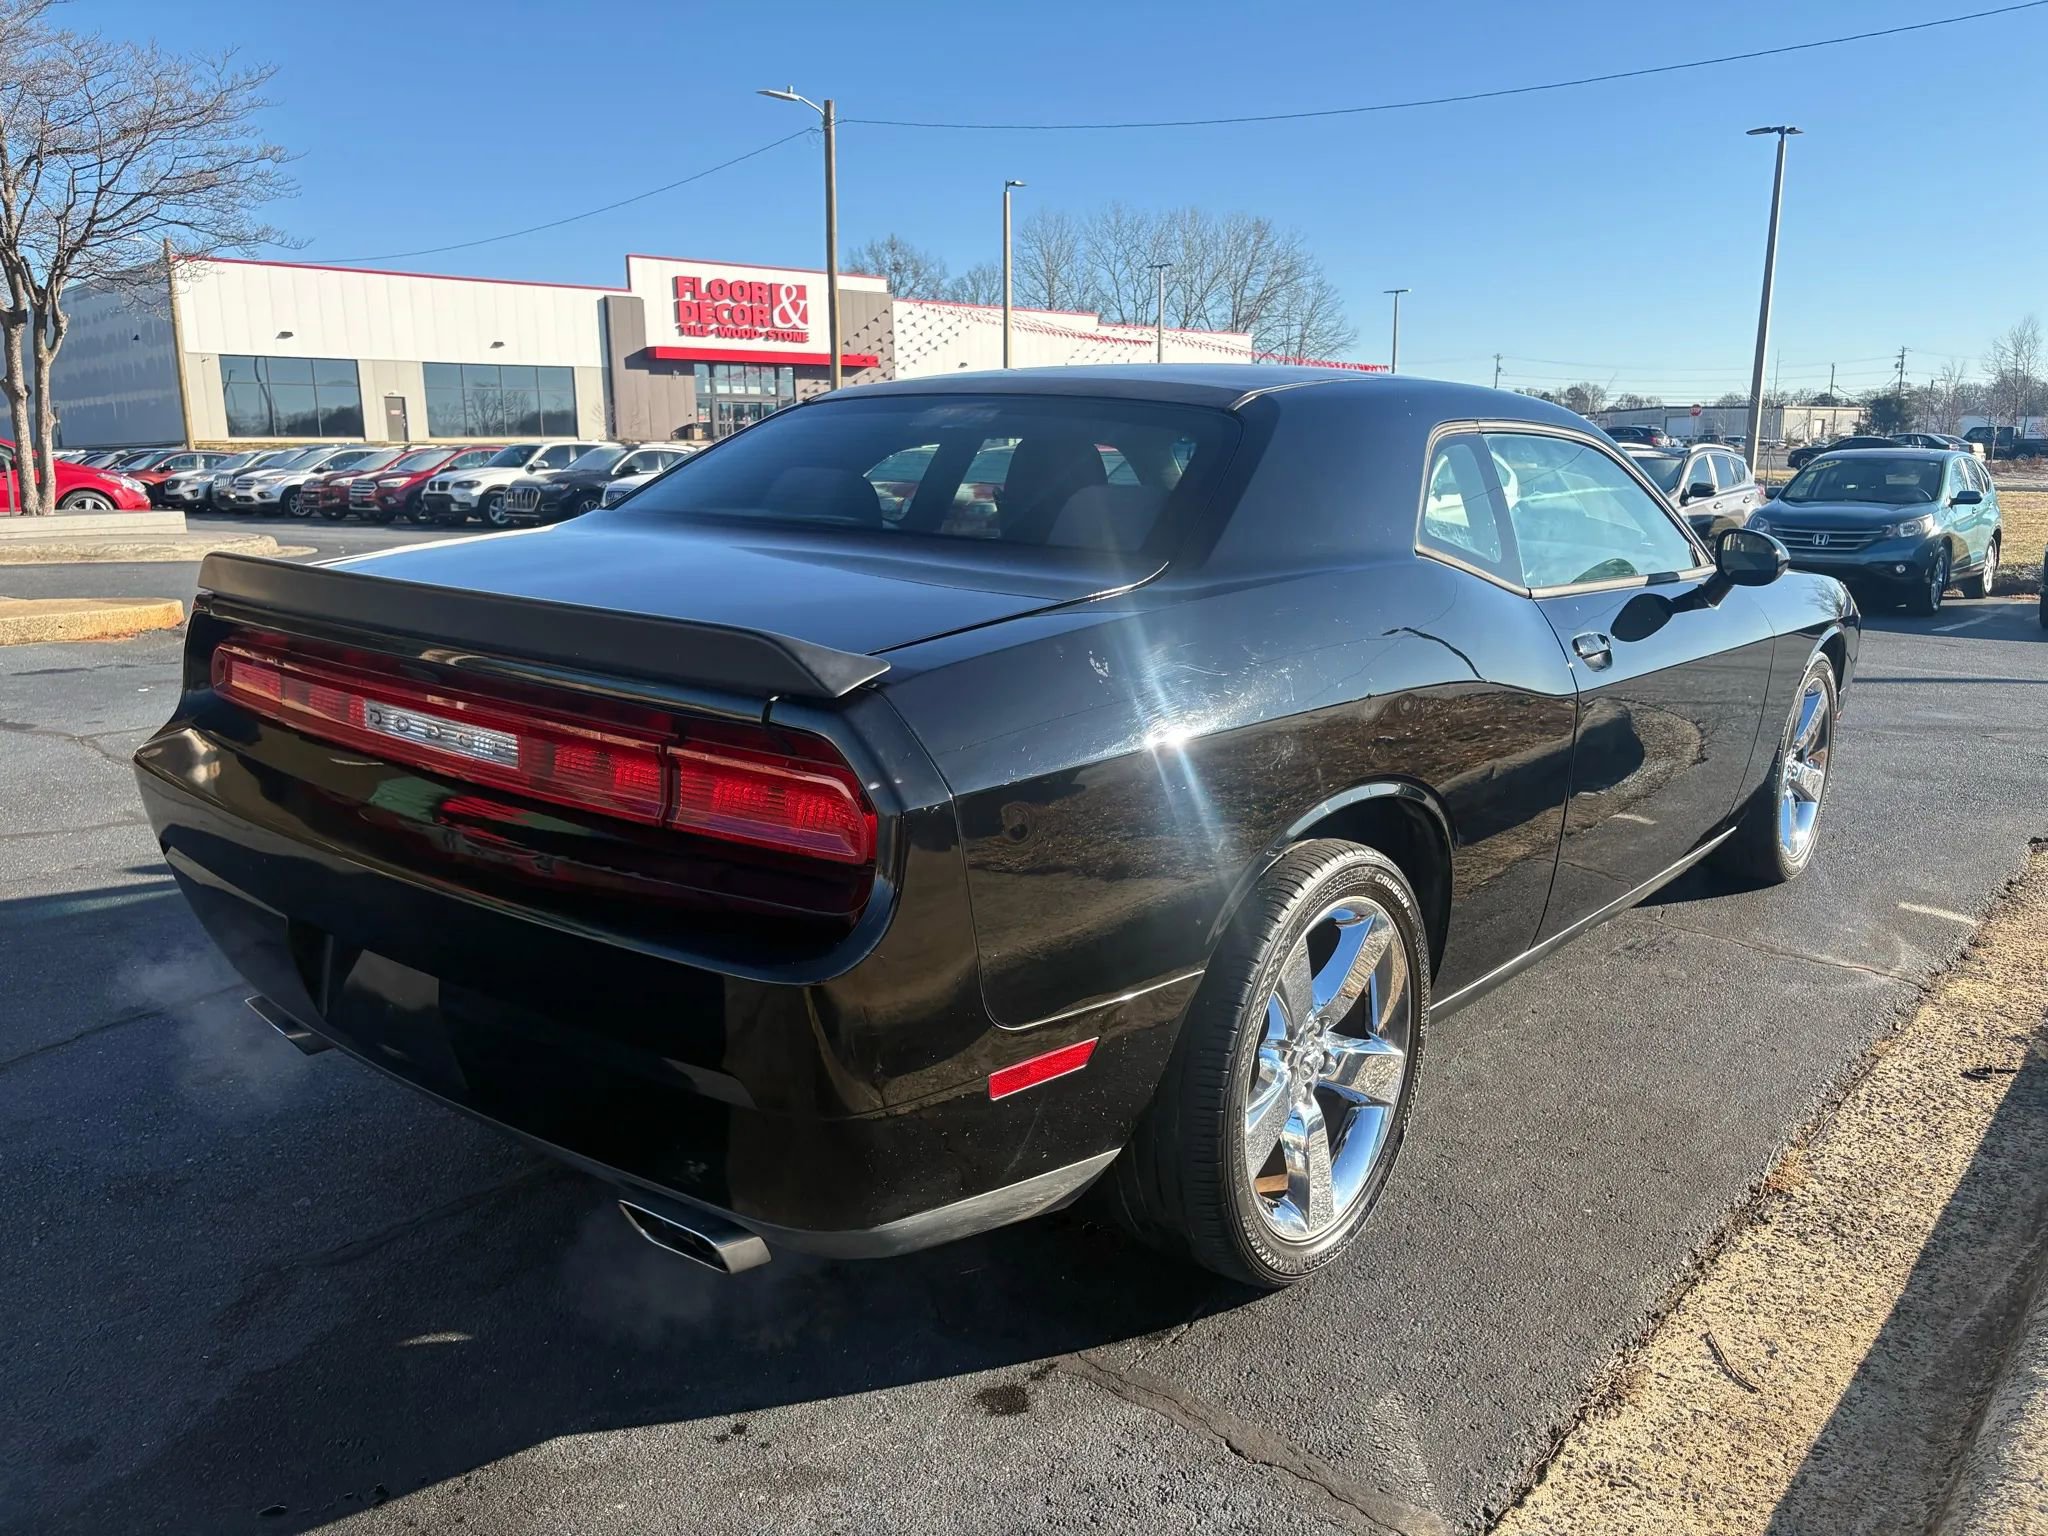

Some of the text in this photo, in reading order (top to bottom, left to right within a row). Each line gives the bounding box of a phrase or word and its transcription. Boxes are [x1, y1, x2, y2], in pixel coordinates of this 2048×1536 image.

[673, 276, 808, 329] FLOOR &
[674, 301, 771, 327] DECOR
[766, 330, 809, 343] STONE
[370, 708, 507, 757] DODGE
